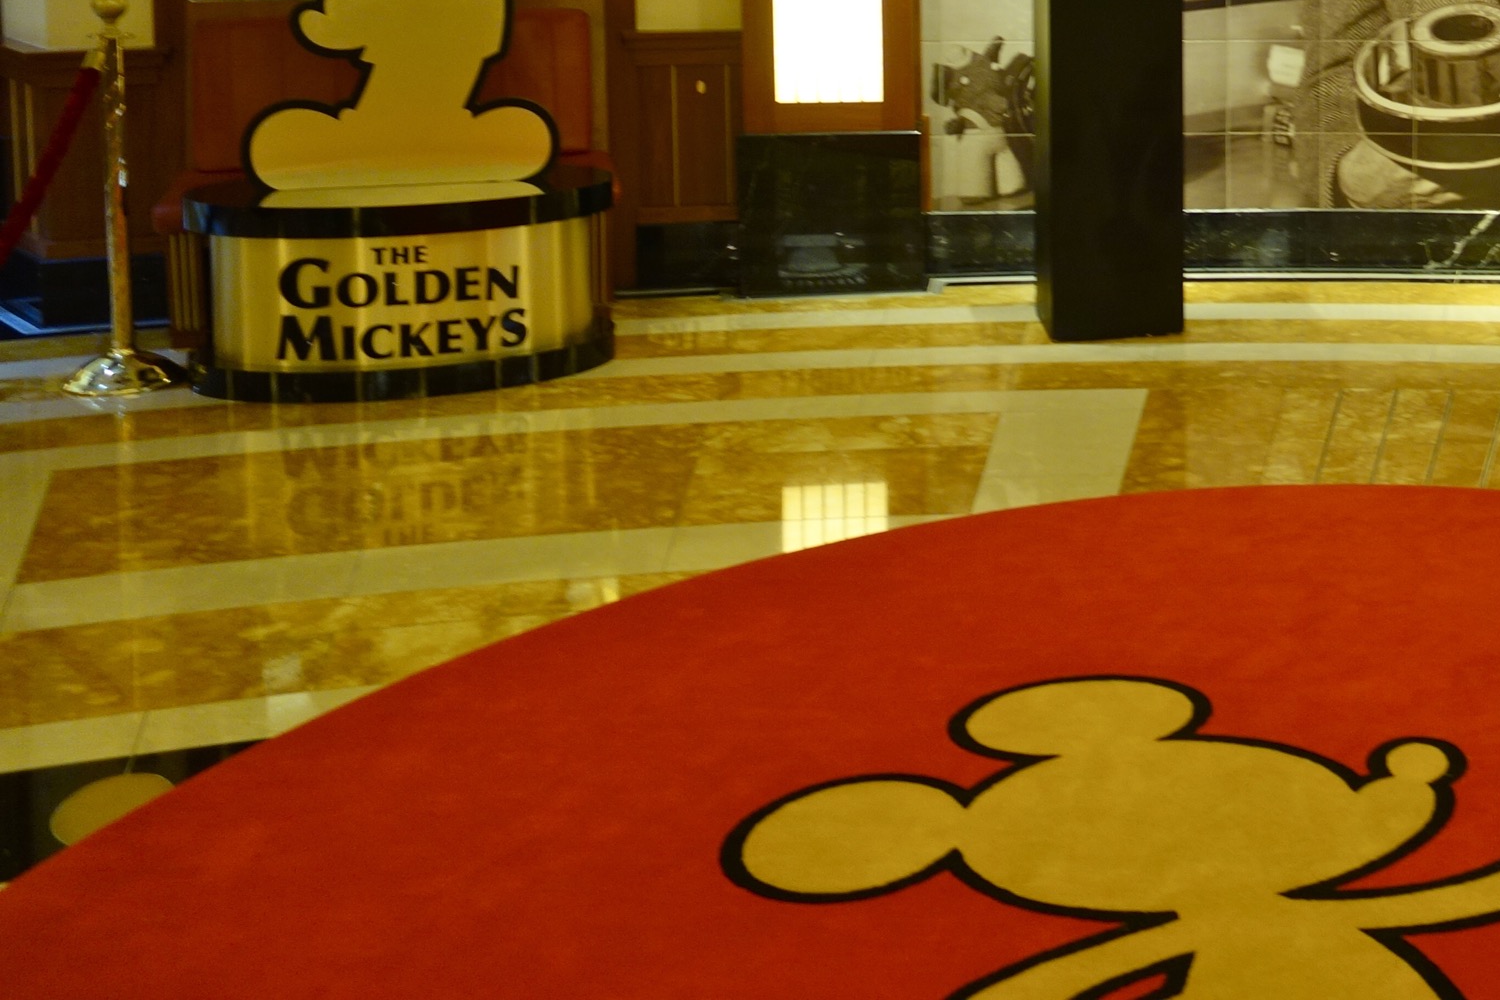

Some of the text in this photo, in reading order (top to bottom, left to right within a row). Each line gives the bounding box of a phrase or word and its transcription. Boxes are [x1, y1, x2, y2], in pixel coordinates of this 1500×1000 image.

[371, 245, 428, 265] THE
[278, 257, 520, 310] GOLDEN
[276, 308, 528, 362] MICKEYS
